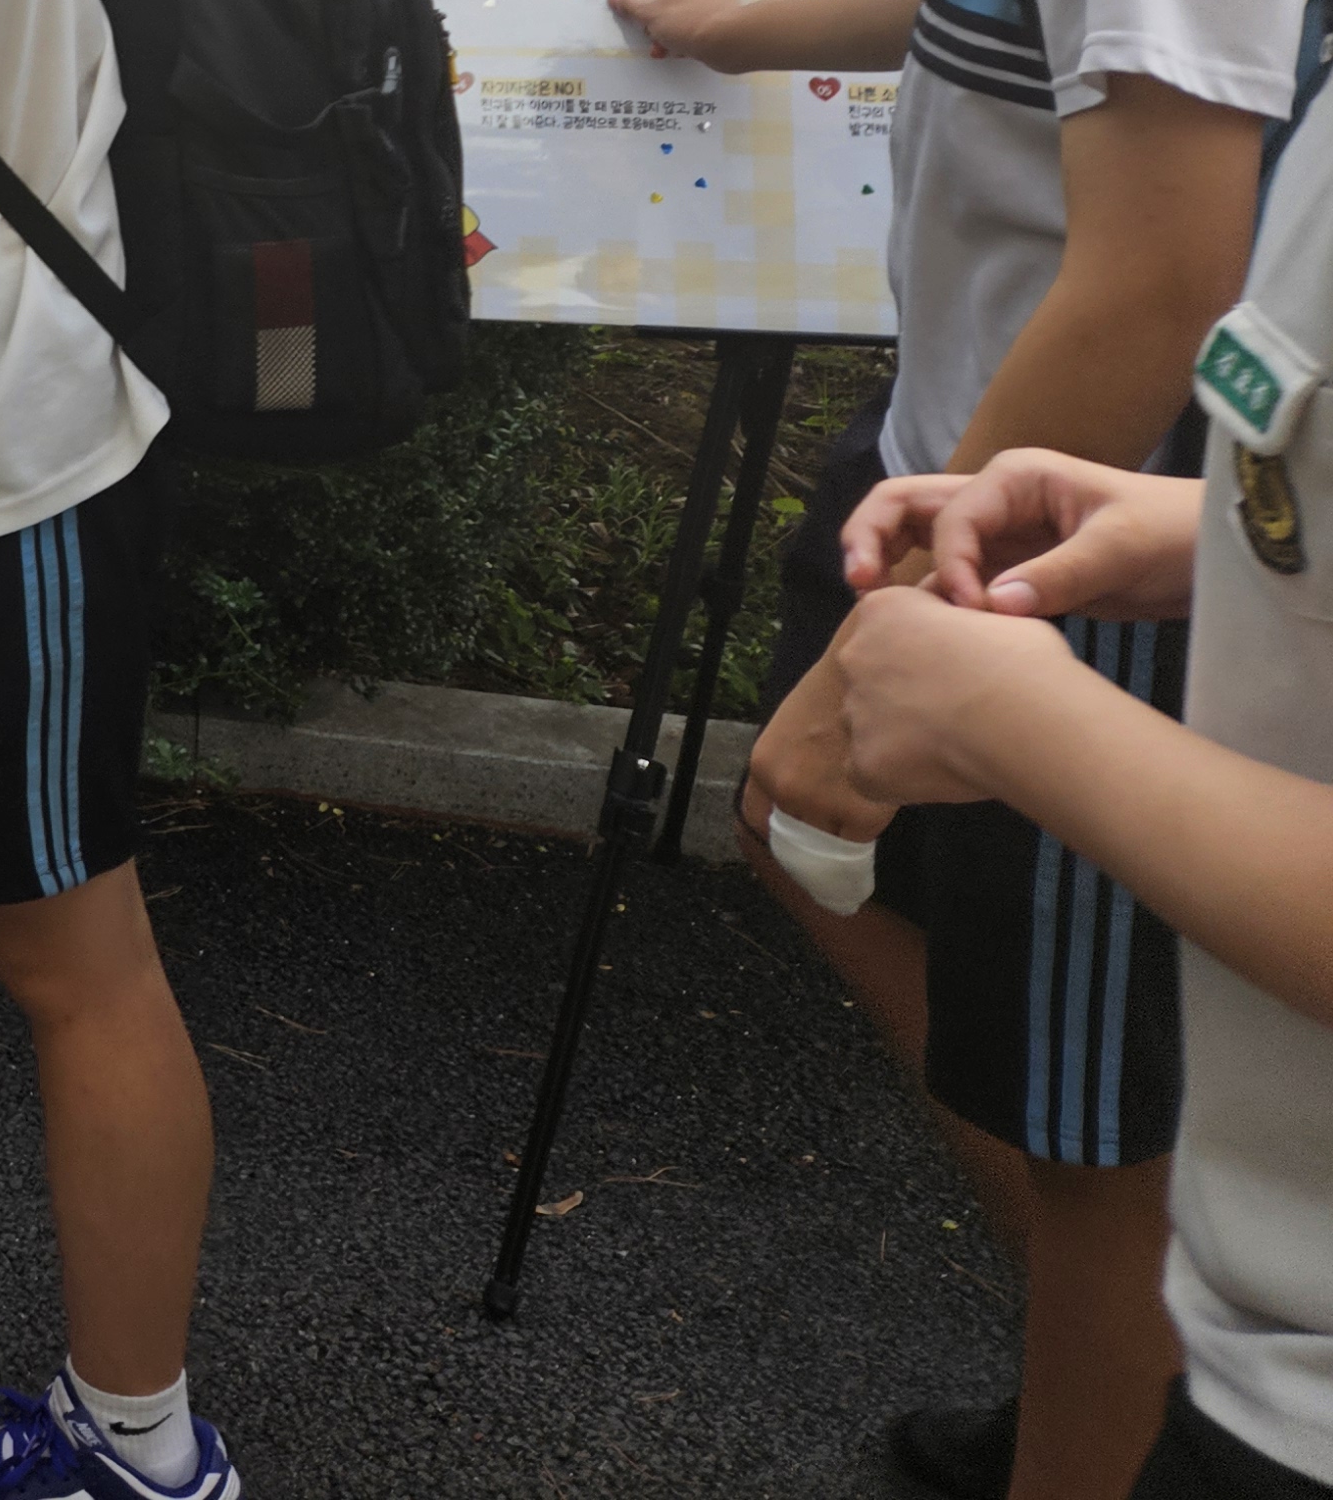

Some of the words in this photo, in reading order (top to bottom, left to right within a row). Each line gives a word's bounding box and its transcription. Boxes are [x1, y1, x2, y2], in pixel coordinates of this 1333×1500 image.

[481, 81, 551, 96] 자기자랑은
[848, 87, 876, 102] 나쁜
[530, 99, 574, 113] 이야기를
[580, 99, 592, 113] 할
[595, 100, 607, 112] 때
[611, 100, 633, 114] 말을
[693, 101, 716, 116] 끝가
[849, 105, 884, 118] 친구의
[482, 115, 493, 127] 지
[497, 115, 508, 128] 잘
[513, 115, 560, 129] 들어준다.
[564, 116, 618, 130] 긍정적으로
[622, 116, 681, 131] 호응해준다.
[849, 122, 892, 136] 발견해
